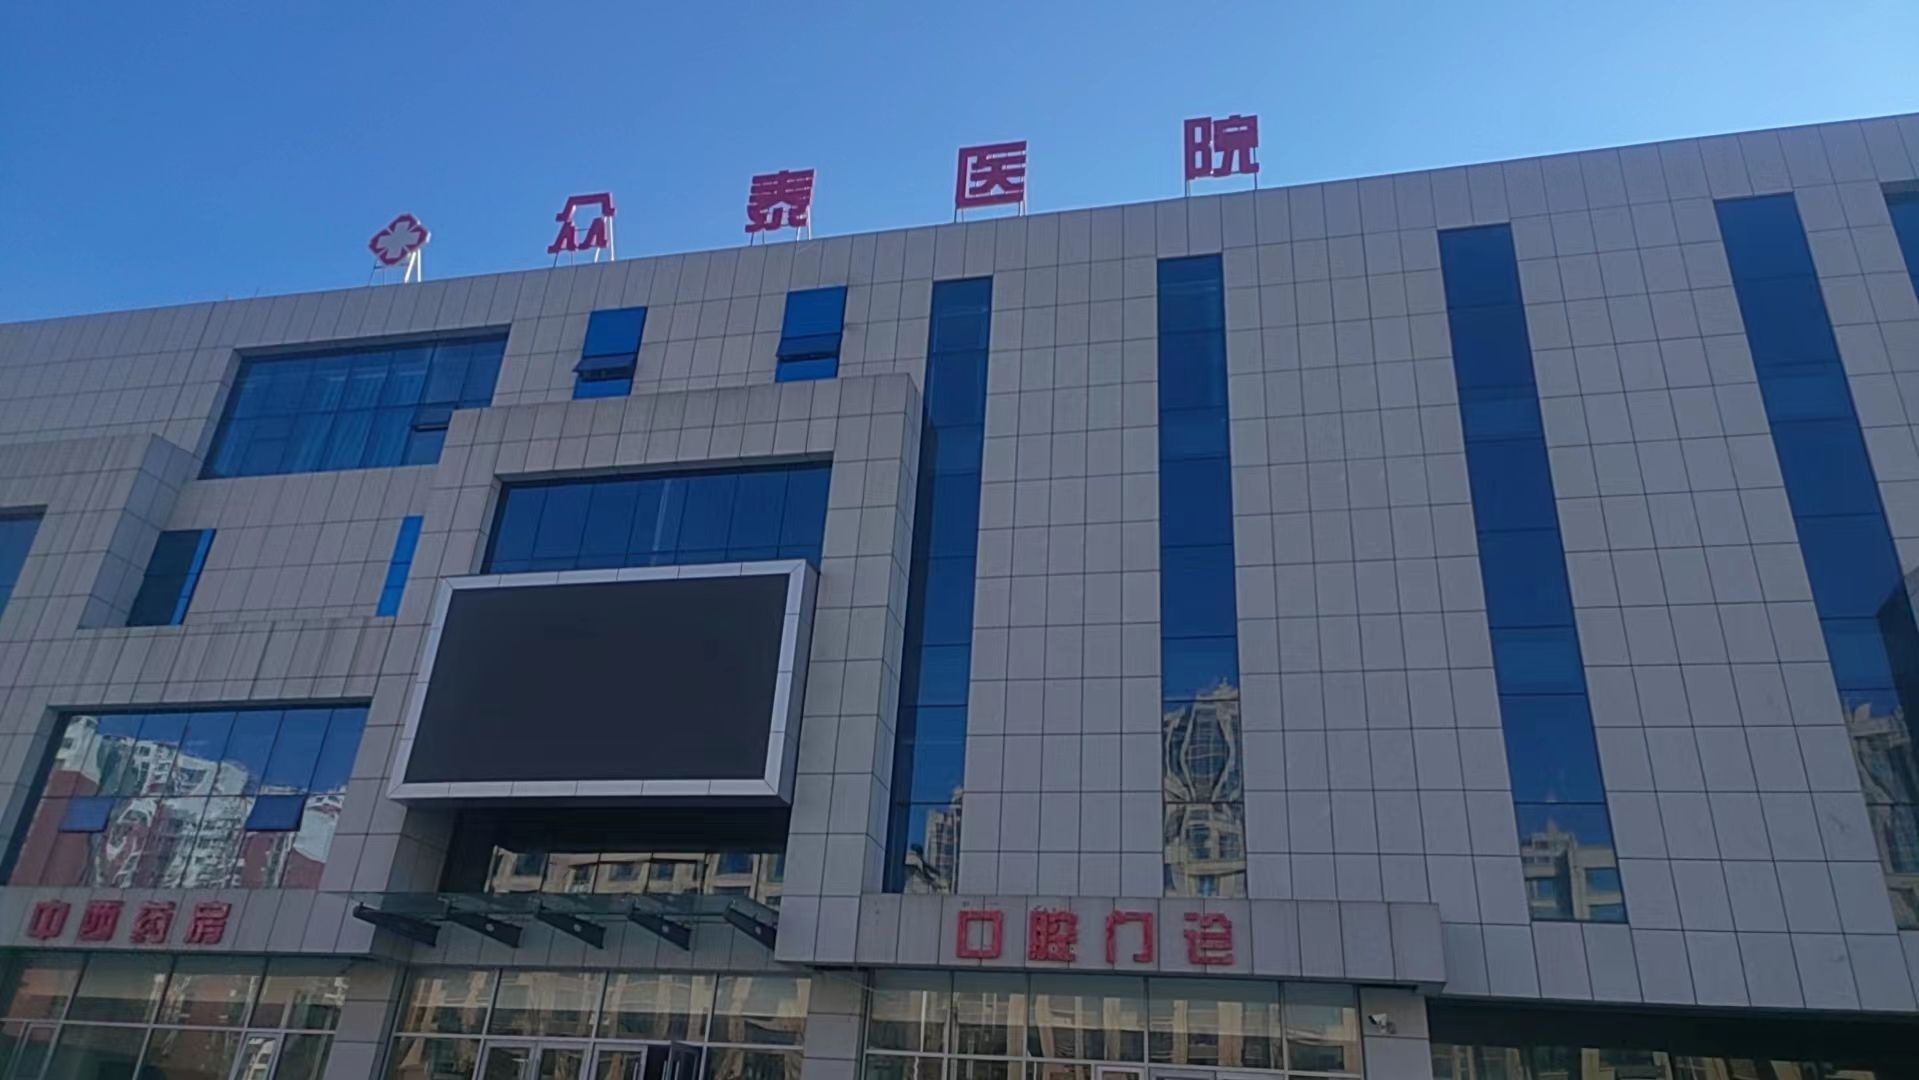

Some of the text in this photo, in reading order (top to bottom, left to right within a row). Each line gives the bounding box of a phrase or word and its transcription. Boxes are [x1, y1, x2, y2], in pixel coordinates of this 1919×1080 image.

[548, 114, 1259, 254] 众泰医院
[26, 899, 232, 945] 中西药房
[956, 910, 1234, 965] 口腔门诊
